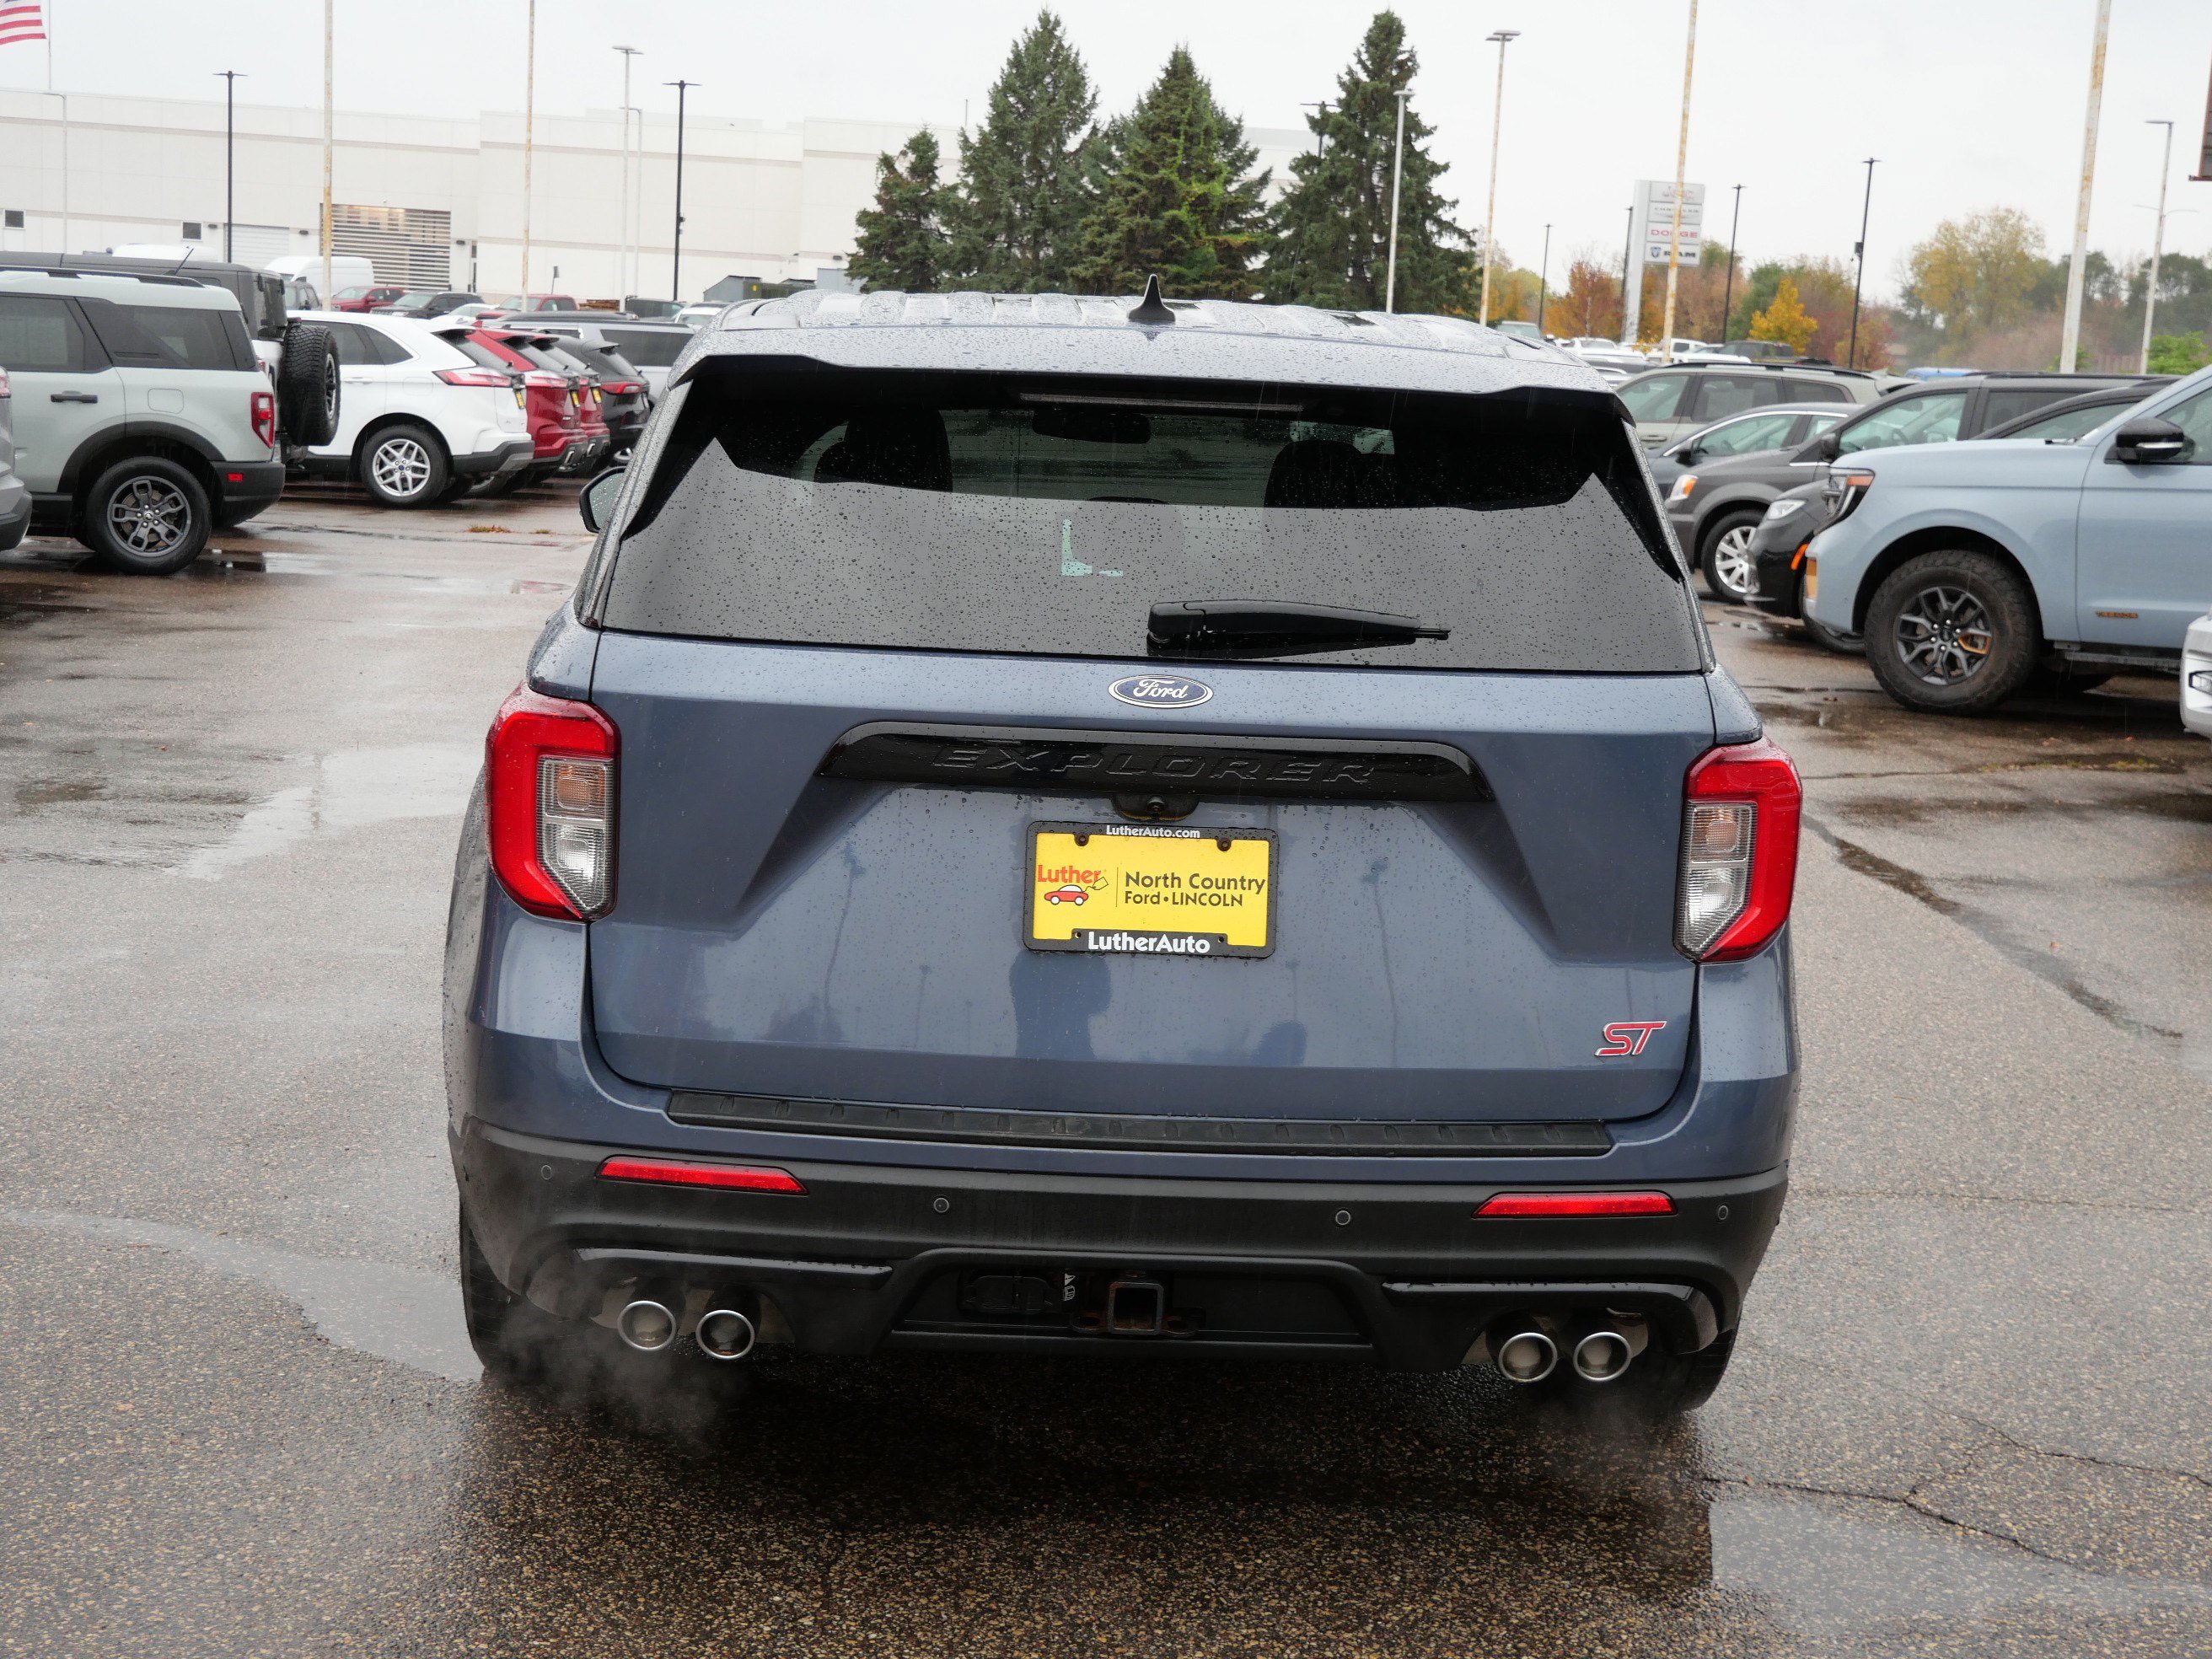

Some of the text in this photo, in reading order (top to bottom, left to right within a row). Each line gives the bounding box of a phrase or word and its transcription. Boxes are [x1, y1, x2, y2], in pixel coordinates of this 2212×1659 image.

[1651, 229, 1698, 239] DOGE
[1133, 679, 1189, 700] Ford
[932, 748, 1376, 783] EXPLORER
[1106, 824, 1200, 839] LutherAuto.com
[1037, 865, 1101, 883] Luther
[1125, 871, 1265, 894] North Country
[1087, 932, 1211, 954] LutherAuto
[1594, 1020, 1667, 1056] ST
